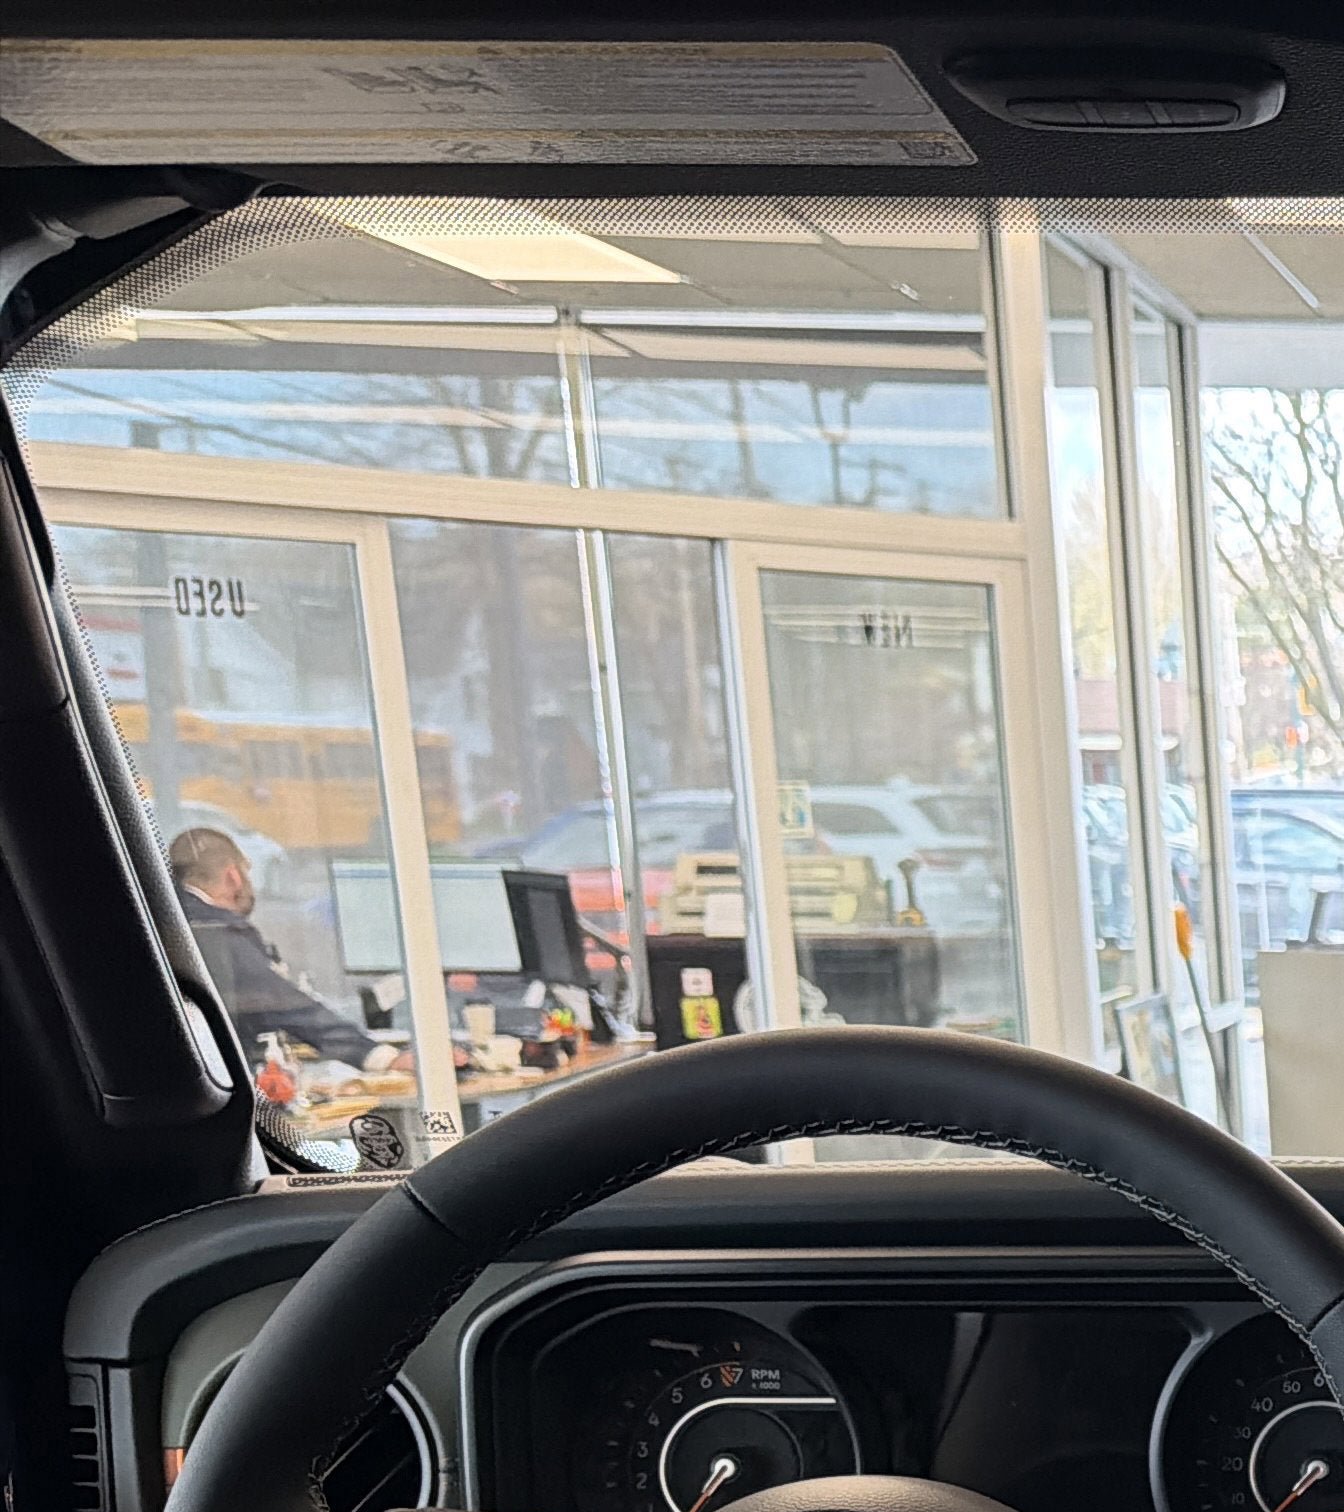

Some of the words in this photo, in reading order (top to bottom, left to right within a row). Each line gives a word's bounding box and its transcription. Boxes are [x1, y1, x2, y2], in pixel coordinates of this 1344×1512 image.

[701, 1372, 713, 1389] 6
[751, 1369, 780, 1380] RPM
[1282, 1380, 1301, 1394] 50
[671, 1387, 683, 1404] 5
[1251, 1397, 1273, 1413] 40
[637, 1441, 648, 1458] 3
[1222, 1456, 1243, 1472] 20
[636, 1472, 648, 1490] 2
[1232, 1492, 1245, 1504] 10
